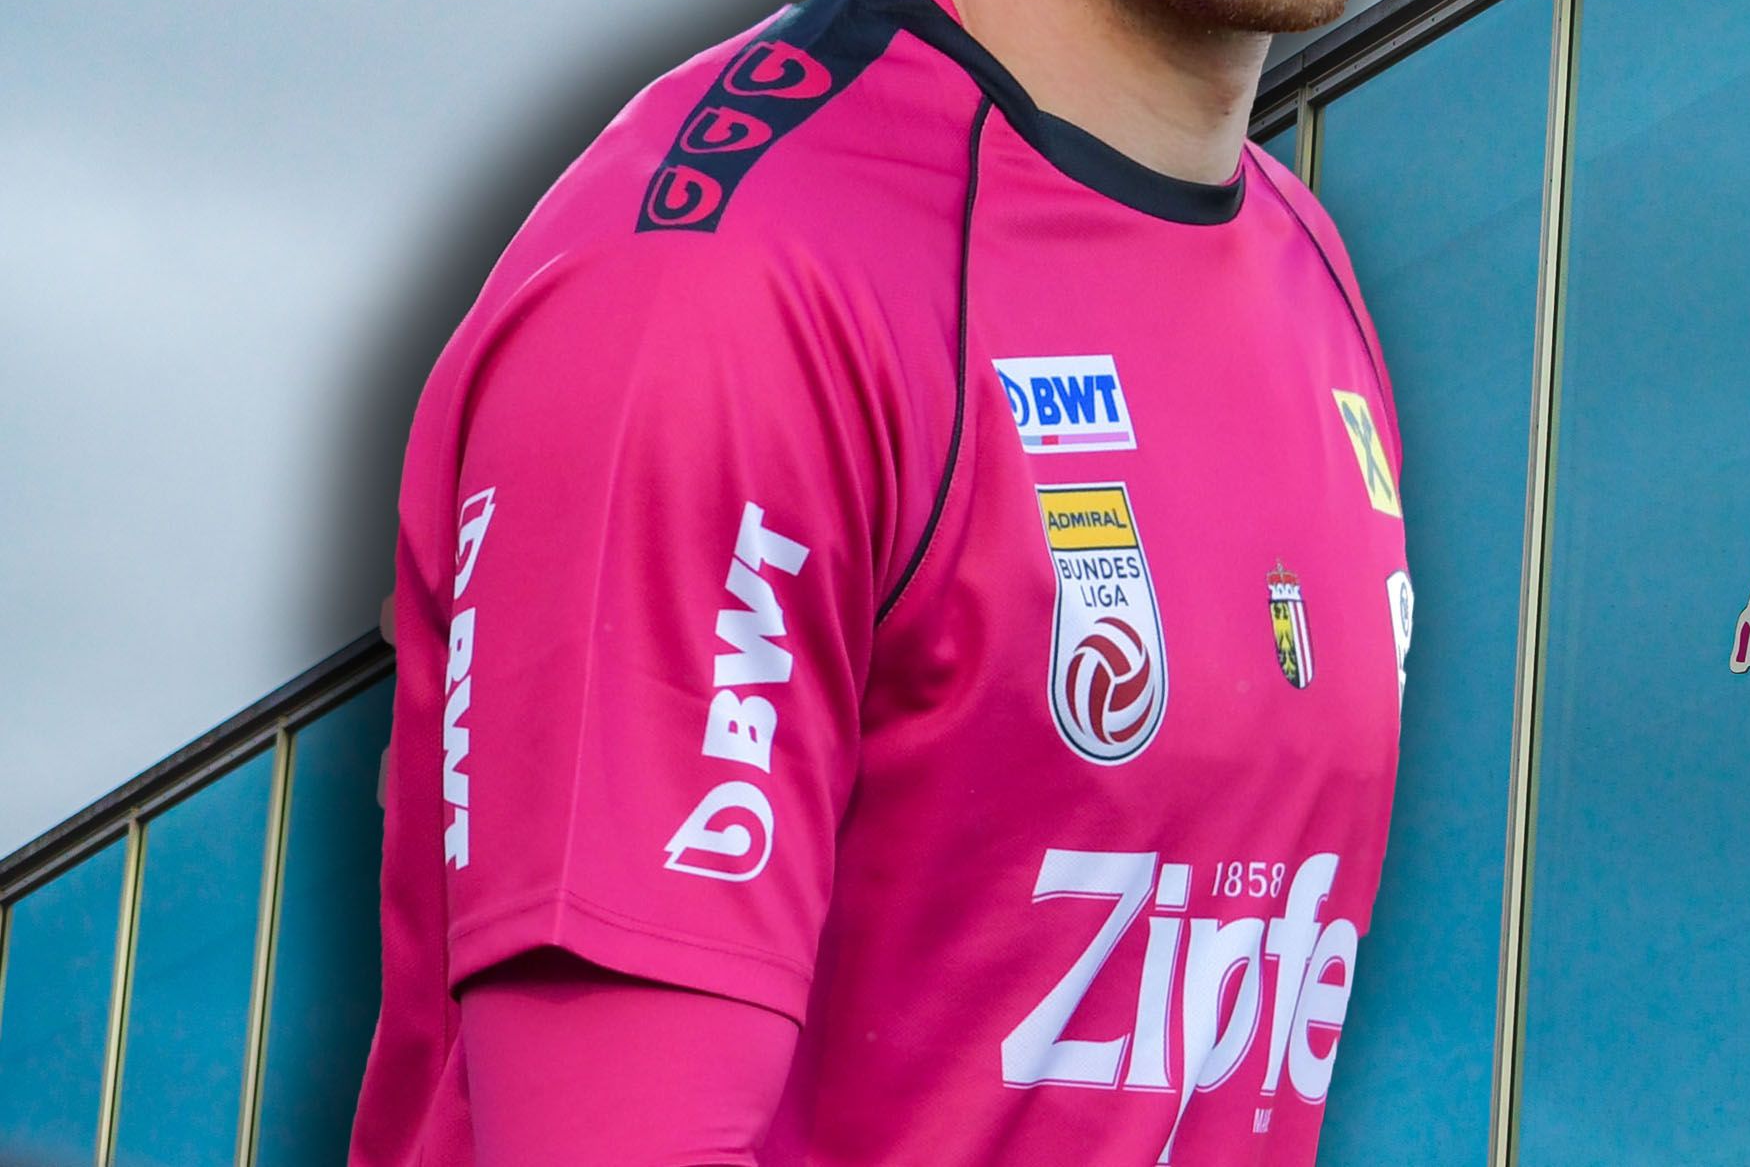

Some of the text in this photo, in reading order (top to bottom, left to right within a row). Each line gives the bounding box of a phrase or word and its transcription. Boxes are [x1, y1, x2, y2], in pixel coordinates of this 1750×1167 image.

[1030, 374, 1120, 426] BWT
[1047, 509, 1128, 532] ADMIRAL
[1057, 555, 1141, 581] BUNDES
[1079, 584, 1130, 608] LIGA
[700, 500, 811, 774] BWT
[1210, 860, 1286, 899] 1858
